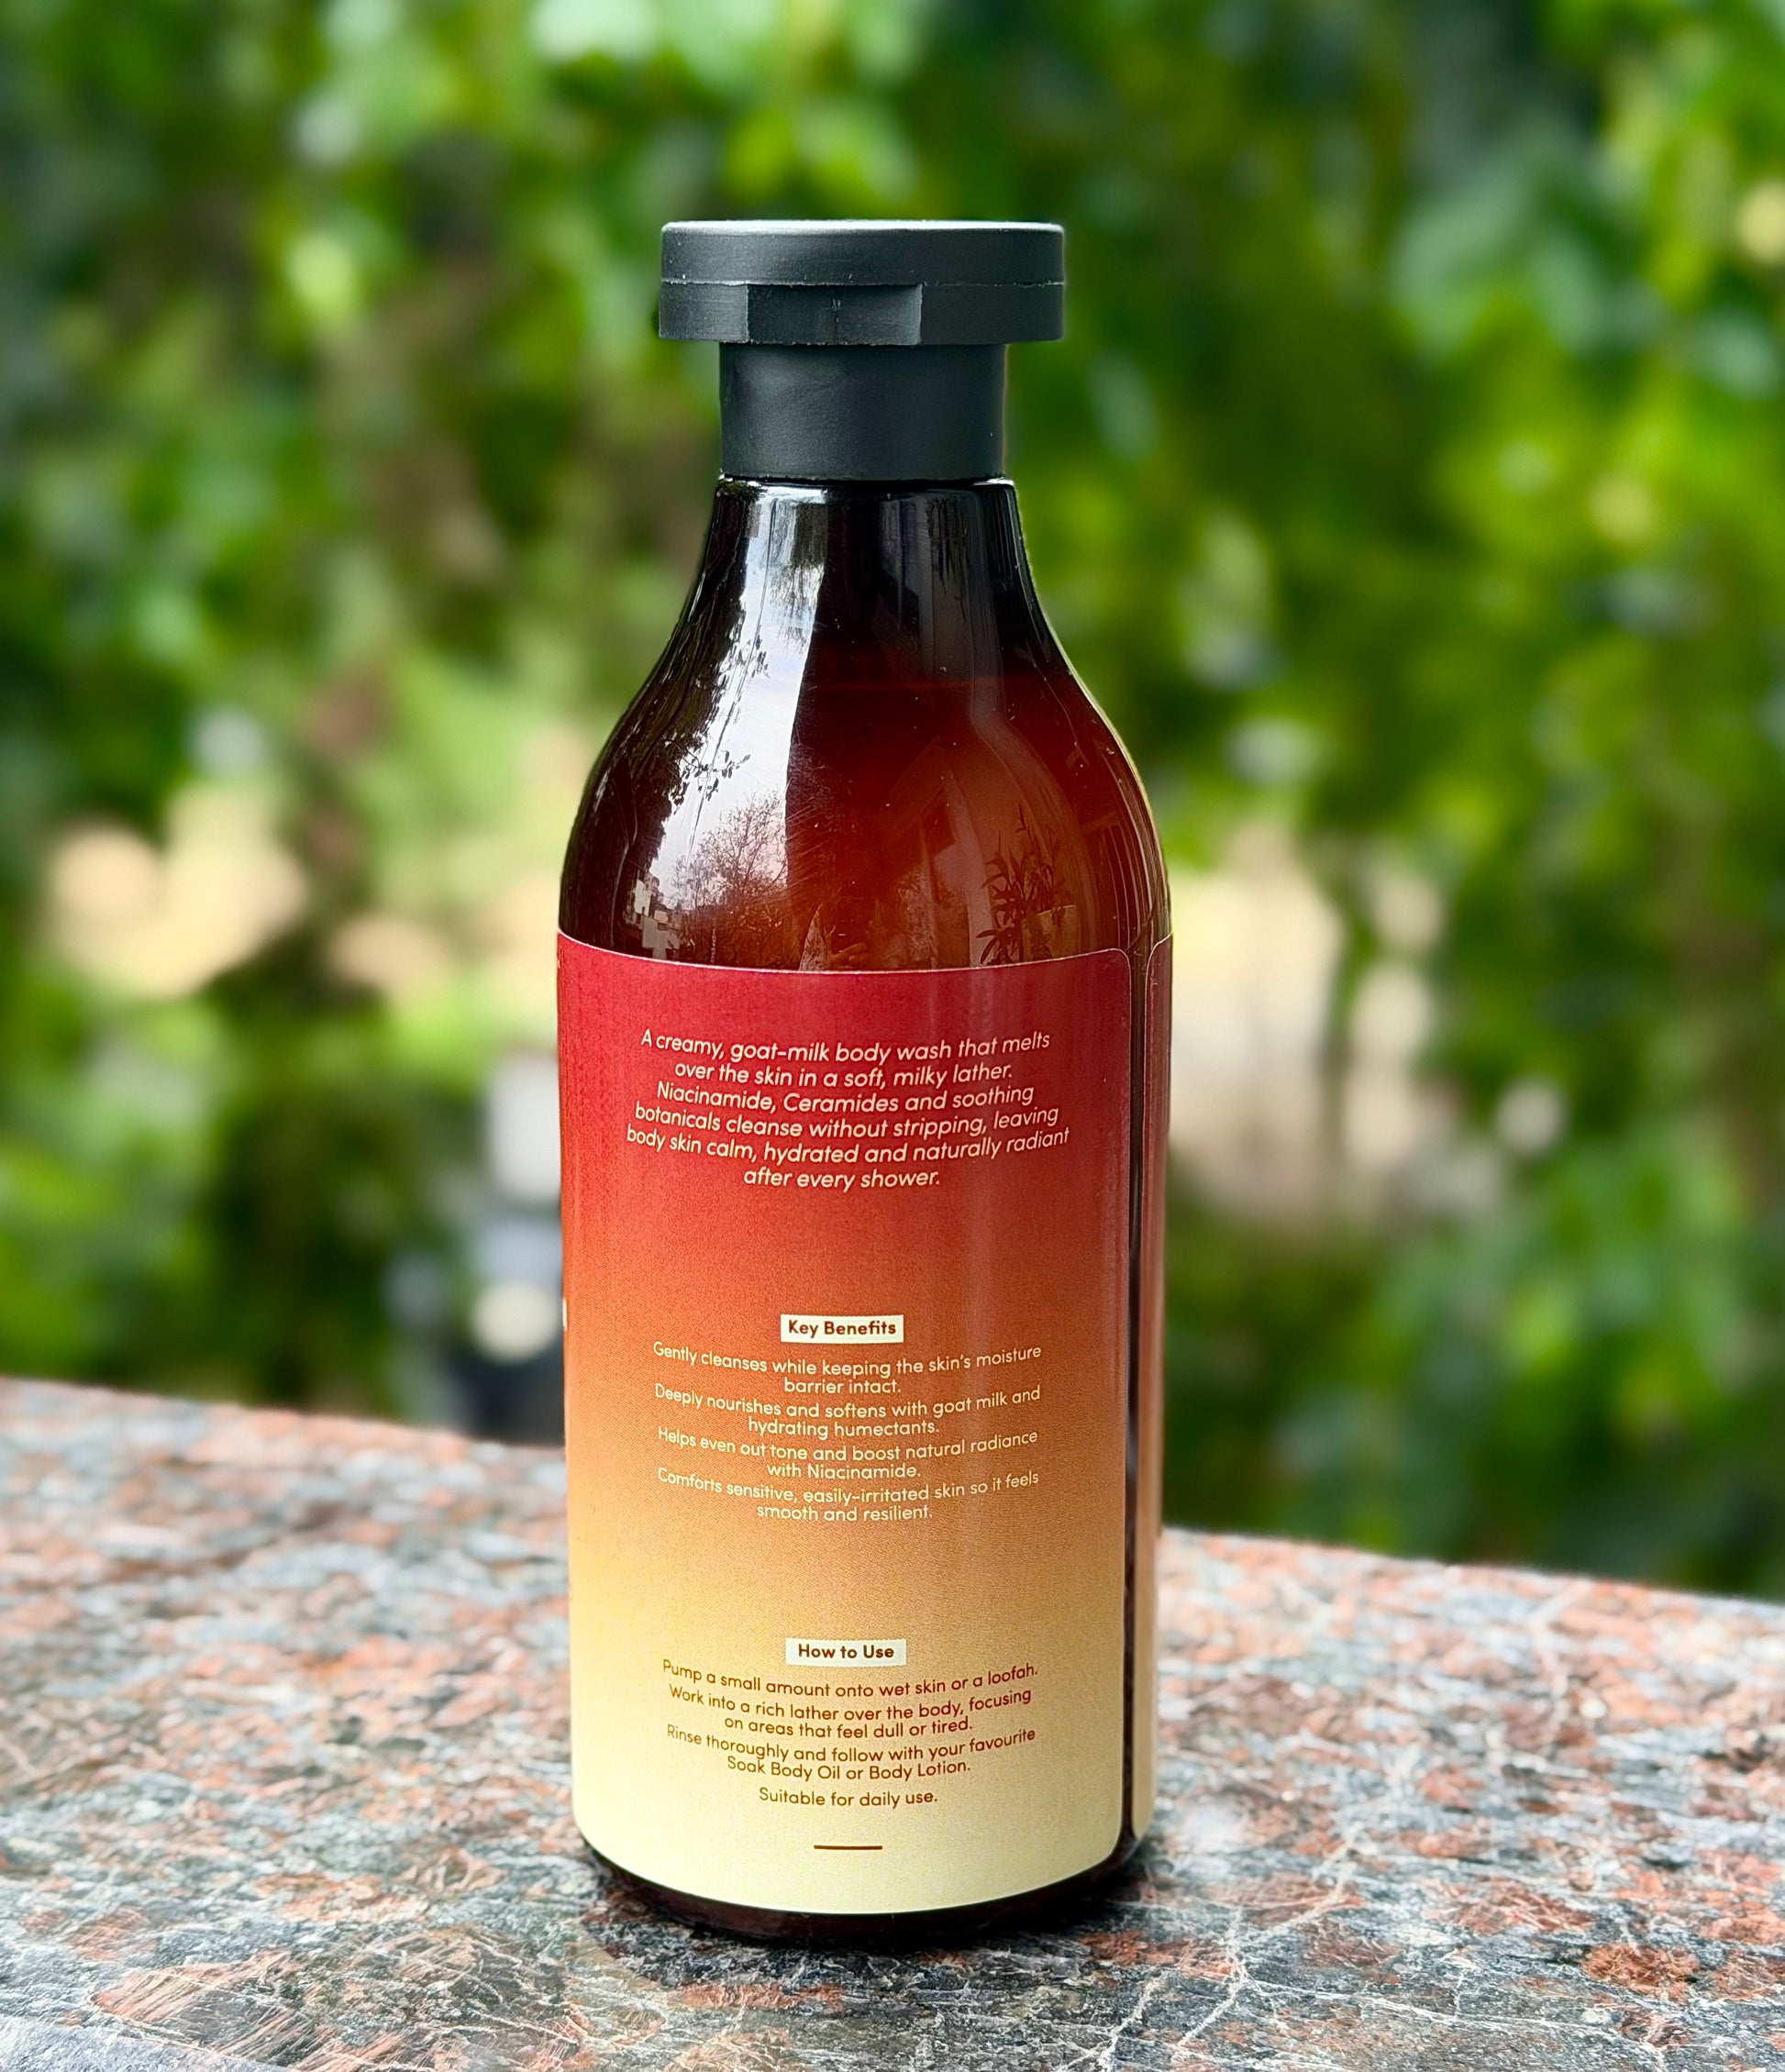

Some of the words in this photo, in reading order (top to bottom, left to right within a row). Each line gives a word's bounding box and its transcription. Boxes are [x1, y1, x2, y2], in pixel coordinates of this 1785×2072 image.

[640, 1028, 652, 1047] A
[655, 1035, 725, 1060] creamy,
[729, 1041, 830, 1063] goat-milk
[835, 1041, 892, 1067] body
[896, 1039, 952, 1061] wash
[958, 1036, 998, 1058] that
[1002, 1030, 1050, 1054] melts
[674, 1062, 715, 1080] over
[718, 1062, 749, 1084] the
[754, 1065, 793, 1086] skin
[798, 1068, 817, 1087] in
[823, 1072, 838, 1088] a
[843, 1067, 886, 1091] soft,
[892, 1064, 948, 1090] milky
[952, 1061, 1013, 1083] lather.
[657, 1080, 776, 1114] Niacinamide,
[782, 1092, 899, 1113] Ceramides
[904, 1090, 948, 1112] and
[952, 1084, 1035, 1109] soothing
[635, 1100, 721, 1132] botanicals
[726, 1114, 804, 1137] cleanse
[808, 1117, 889, 1138] without
[892, 1114, 987, 1141] stripping,
[993, 1105, 1059, 1130] leaving
[626, 1122, 667, 1153] body
[669, 1132, 702, 1155] skin
[706, 1138, 758, 1163] calm,
[763, 1140, 860, 1167] hydrated
[864, 1142, 908, 1163] and
[913, 1136, 1003, 1161] naturally
[1005, 1126, 1070, 1153] radiant
[743, 1166, 793, 1187] after
[796, 1173, 856, 1193] every
[859, 1168, 940, 1189] shower.
[788, 1319, 819, 1339] Key
[824, 1320, 896, 1335] Benefits
[653, 1341, 698, 1367] Gently
[700, 1349, 768, 1373] cleanses
[771, 1357, 817, 1375] while
[822, 1358, 892, 1379] keeping
[895, 1357, 924, 1374] the
[976, 1346, 1042, 1368] moisture
[655, 1382, 704, 1410] Deeply
[706, 1396, 782, 1416] nourishes
[786, 1402, 820, 1418] and
[825, 1402, 887, 1419] softens
[891, 1400, 928, 1417] with
[932, 1397, 972, 1419] goat
[976, 1391, 1008, 1411] milk
[1012, 1384, 1040, 1404] and
[784, 1376, 845, 1394] barrier
[848, 1379, 902, 1394] intact.
[658, 1425, 697, 1449] Helps
[700, 1437, 737, 1454] even
[739, 1443, 767, 1457] out
[770, 1444, 808, 1460] tone
[812, 1445, 847, 1461] and
[852, 1445, 901, 1461] boost
[905, 1438, 965, 1459] natural
[970, 1432, 1038, 1453] radiance
[748, 1415, 828, 1441] hydrating
[834, 1419, 939, 1437] humectants.
[658, 1467, 723, 1493] Comforts
[726, 1483, 798, 1503] sensitive,
[803, 1484, 929, 1507] easily-irritated
[934, 1482, 965, 1500] skin
[970, 1482, 988, 1495] so
[992, 1477, 1003, 1491] it
[1004, 1469, 1039, 1489] feels
[766, 1462, 802, 1478] with
[807, 1462, 921, 1480] Niacinamide.
[757, 1505, 818, 1521] smooth
[823, 1506, 858, 1522] and
[863, 1504, 933, 1522] resilient.
[798, 1643, 837, 1659] How
[839, 1645, 858, 1659] to
[862, 1645, 894, 1659] Use
[662, 1658, 703, 1685] Pump
[705, 1673, 716, 1684] a
[720, 1675, 761, 1692] small
[765, 1682, 831, 1697] amount
[835, 1683, 874, 1698] onto
[878, 1681, 911, 1697] wet
[915, 1679, 947, 1695] skin
[950, 1678, 970, 1691] or
[972, 1676, 983, 1688] a
[987, 1662, 1038, 1686] loofah.
[669, 1683, 704, 1705] Work
[708, 1692, 737, 1712] into
[739, 1702, 750, 1713] a
[755, 1701, 785, 1718] rich
[790, 1703, 840, 1721] lather
[843, 1709, 882, 1722] over
[885, 1704, 914, 1721] the
[918, 1699, 964, 1719] body,
[968, 1690, 1032, 1712] focusing
[667, 1723, 703, 1745] Rinse
[705, 1734, 790, 1763] thoroughly
[793, 1746, 826, 1762] and
[831, 1746, 884, 1763] follow
[887, 1745, 924, 1761] with
[927, 1744, 967, 1763] your
[969, 1728, 1036, 1753] favourite
[724, 1717, 744, 1730] on
[748, 1721, 794, 1736] areas
[798, 1722, 833, 1738] that
[836, 1723, 868, 1739] feel
[872, 1722, 904, 1739] dull
[908, 1724, 927, 1737] or
[931, 1715, 973, 1734] tired.
[726, 1756, 767, 1775] Soak
[771, 1761, 813, 1783] Body
[817, 1765, 840, 1780] Oil
[845, 1768, 865, 1780] or
[869, 1763, 913, 1783] Body
[917, 1759, 971, 1778] Lotion.
[759, 1786, 826, 1806] Suitable
[830, 1791, 855, 1807] for
[859, 1790, 901, 1811] daily
[904, 1791, 938, 1805] use.
